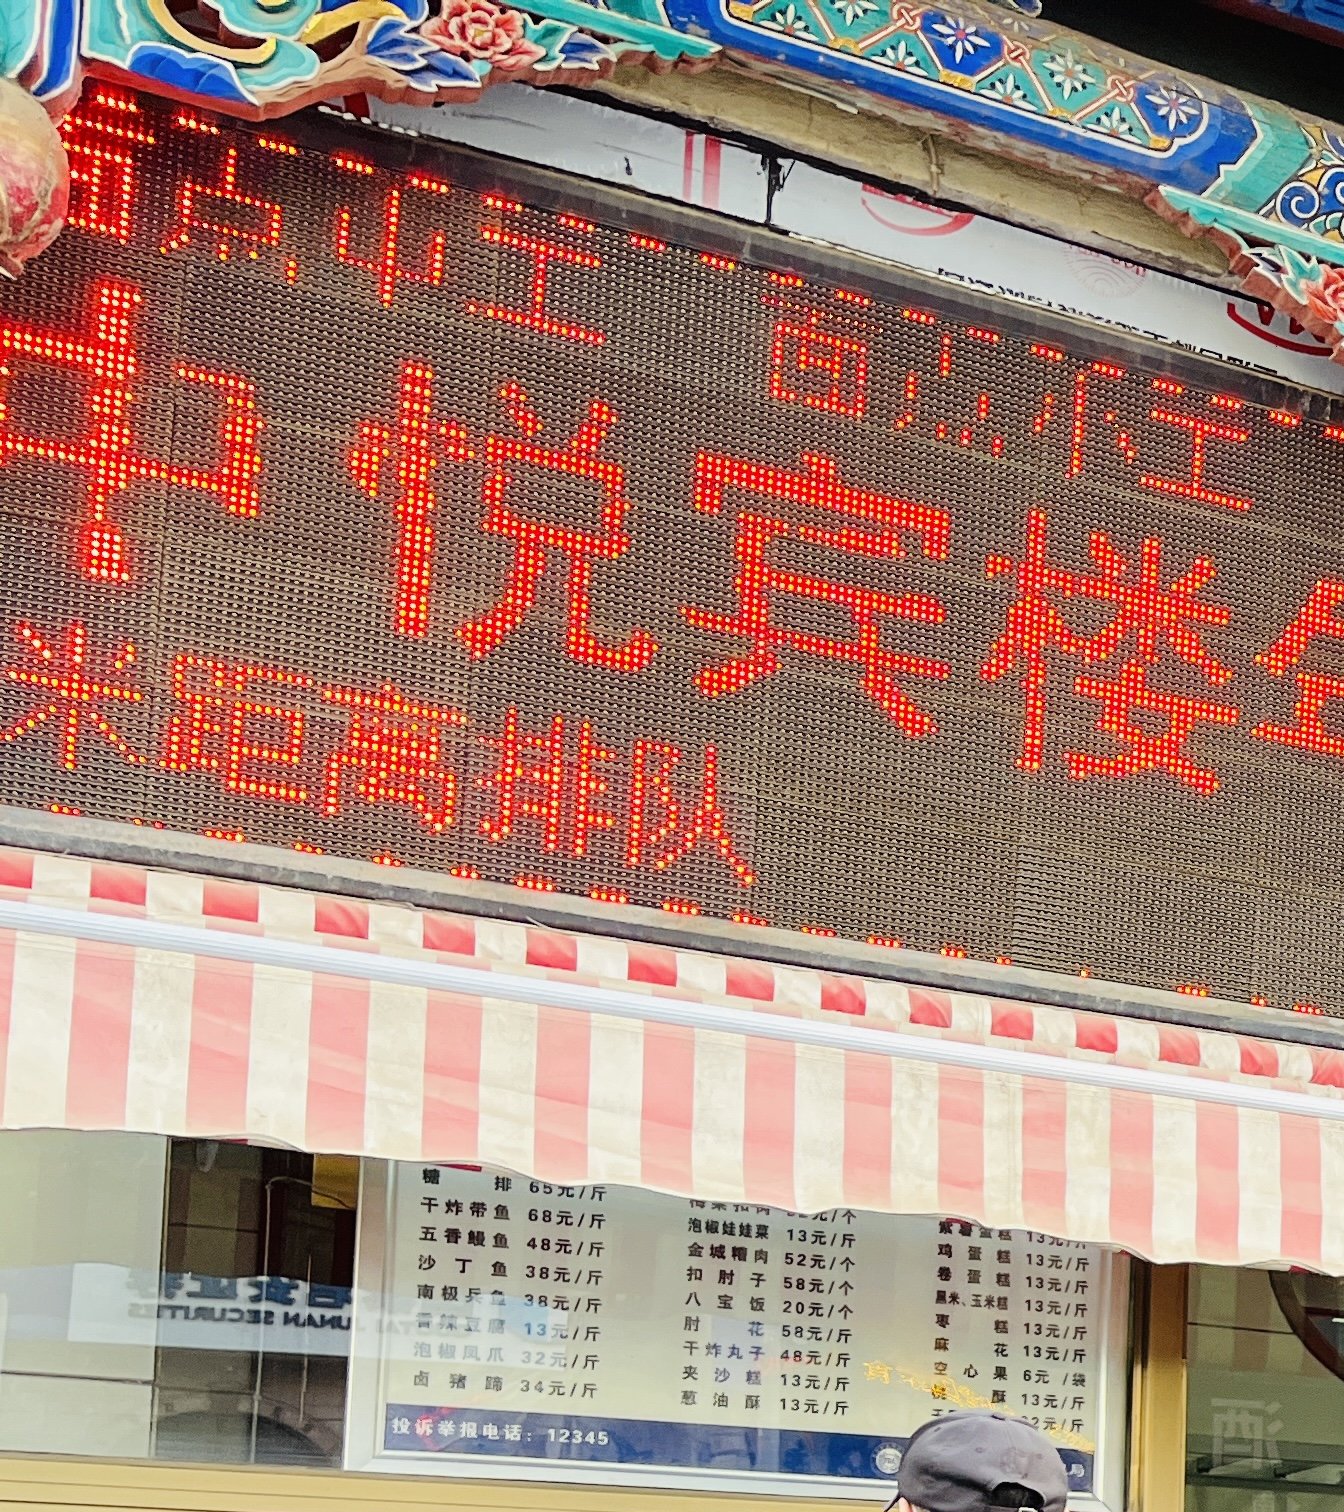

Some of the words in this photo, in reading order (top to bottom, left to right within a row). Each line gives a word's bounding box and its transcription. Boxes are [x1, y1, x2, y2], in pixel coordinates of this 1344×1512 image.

[421, 1197, 510, 1220] 干炸带鱼
[528, 1208, 606, 1230] 68元/斤
[419, 1226, 509, 1249] 五香鳗鱼
[527, 1237, 605, 1258] 48元/斤
[688, 1217, 769, 1240] 泡椒娃娃菜
[787, 1229, 856, 1248] 13元/斤
[418, 1254, 508, 1277] 沙丁鱼
[525, 1265, 604, 1286] 38元/斤
[784, 1252, 856, 1273] 52元/个
[937, 1243, 1011, 1264] 鸡蛋糕
[1026, 1254, 1090, 1272] 13元/斤
[686, 1266, 767, 1288] 扣肘子
[783, 1276, 854, 1297] 58元/个
[1025, 1276, 1089, 1295] 13元/斤
[524, 1294, 602, 1314] 38元/斤
[685, 1291, 765, 1312] 八宝饭
[783, 1300, 854, 1320] 20元/个
[1025, 1300, 1088, 1318] 13元/斤
[524, 1322, 601, 1342] 13元/斤
[684, 1316, 765, 1337] 肘花
[782, 1325, 853, 1344] 58元/斤
[1023, 1322, 1088, 1341] 13元/斤
[413, 1341, 504, 1363] 泡椒凤爪
[521, 1350, 600, 1371] 32元/斤
[683, 1341, 765, 1361] 干炸丸子
[780, 1350, 851, 1368] 48元/斤
[934, 1337, 1009, 1358] 麻花
[1023, 1345, 1087, 1364] 13元/斤
[413, 1370, 504, 1393] 卤猪蹄
[520, 1379, 598, 1399] 34元/斤
[780, 1374, 850, 1392] 13元/斤
[934, 1361, 1008, 1381] 空心果
[780, 1398, 849, 1416] 13元/斤
[1021, 1393, 1085, 1410] 13元/斤
[391, 1416, 533, 1443] 投诉举报电话：
[547, 1428, 610, 1446] 12345
